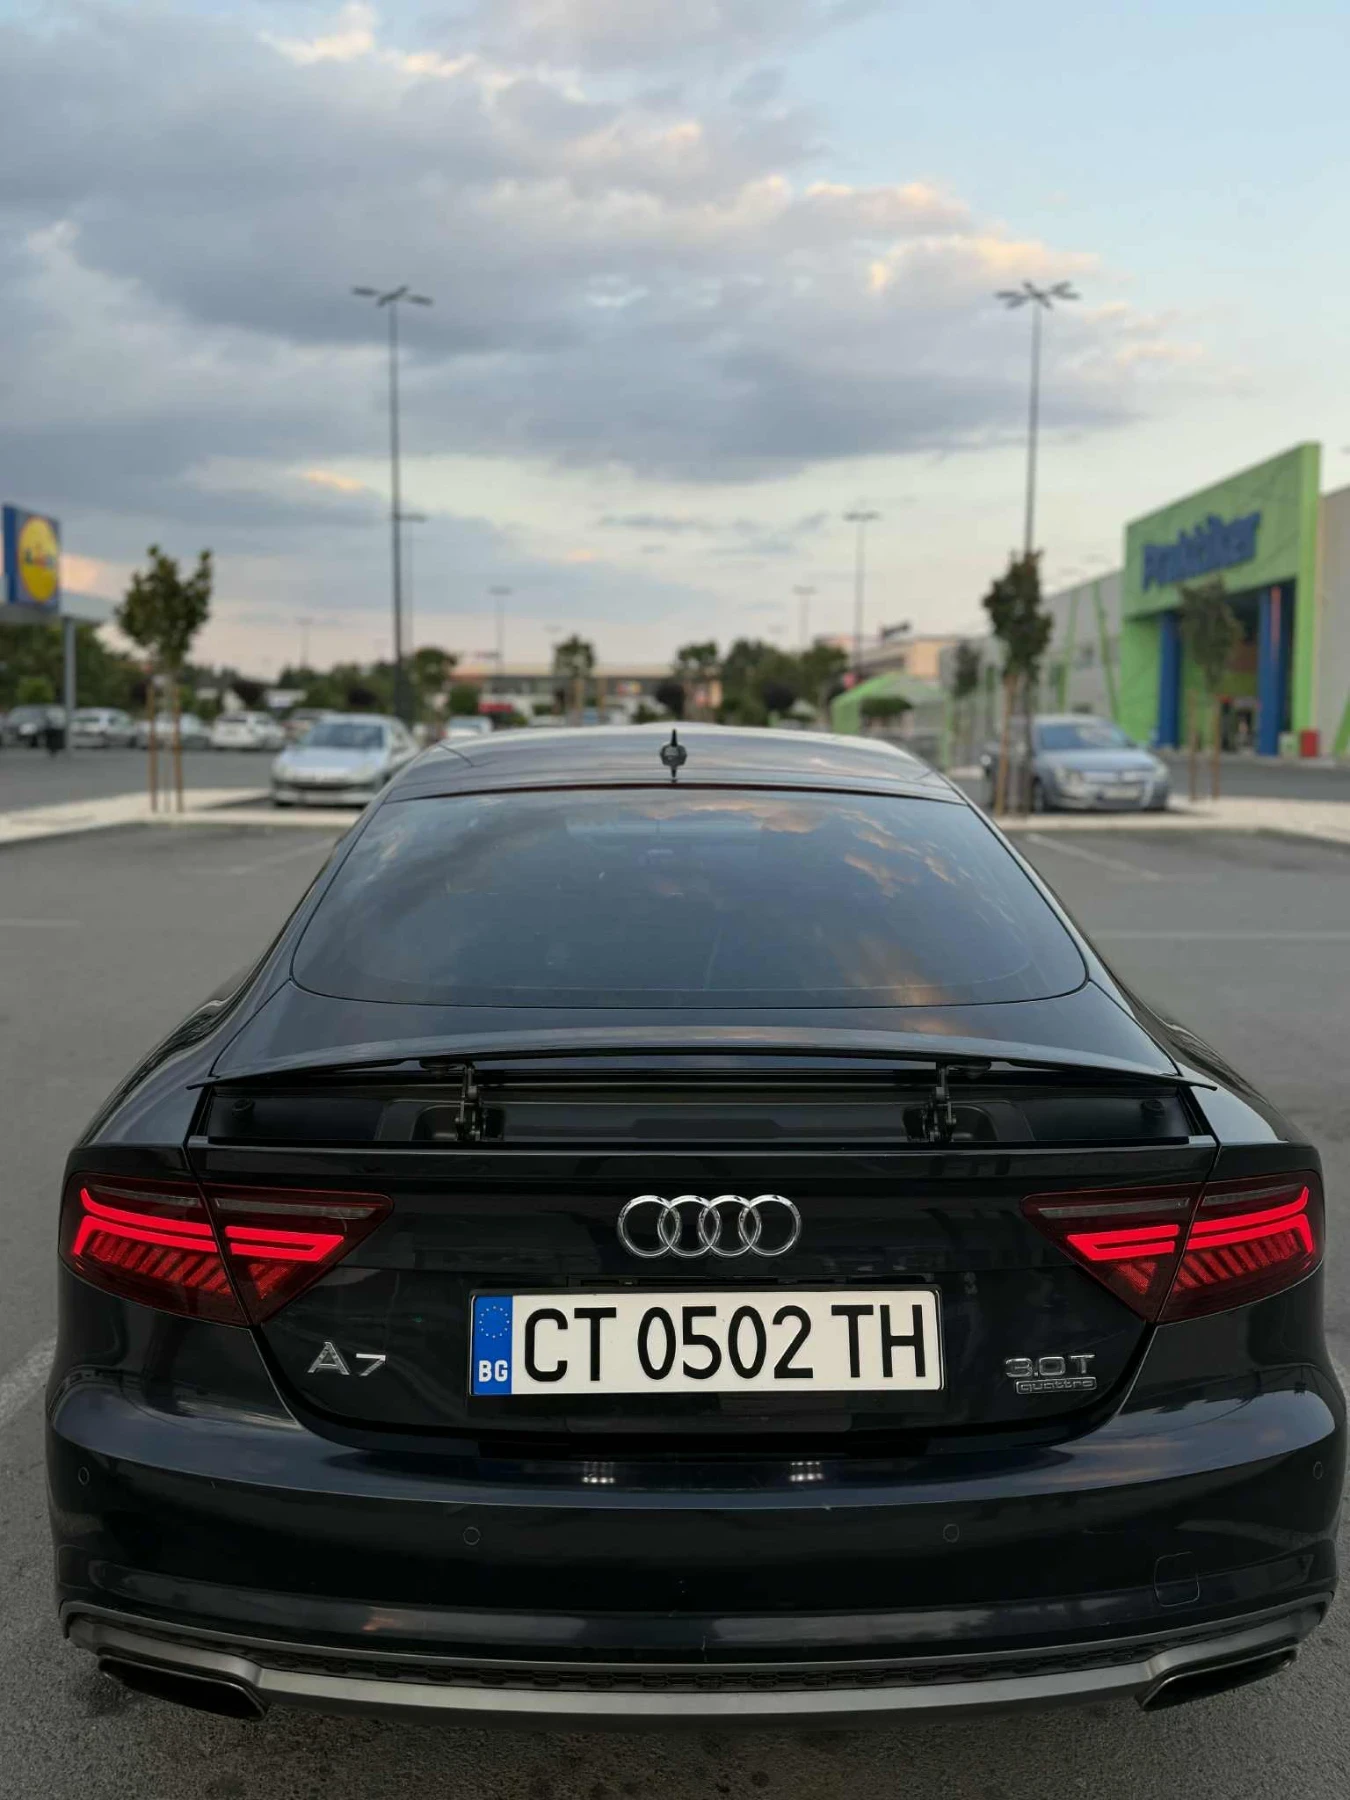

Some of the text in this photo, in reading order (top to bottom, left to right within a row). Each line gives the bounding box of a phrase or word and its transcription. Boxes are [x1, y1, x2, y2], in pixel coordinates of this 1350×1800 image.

[524, 1304, 926, 1382] CT 0502 TH
[307, 1341, 386, 1376] A7
[478, 1359, 508, 1382] BG
[1020, 1380, 1094, 1392] quattro
